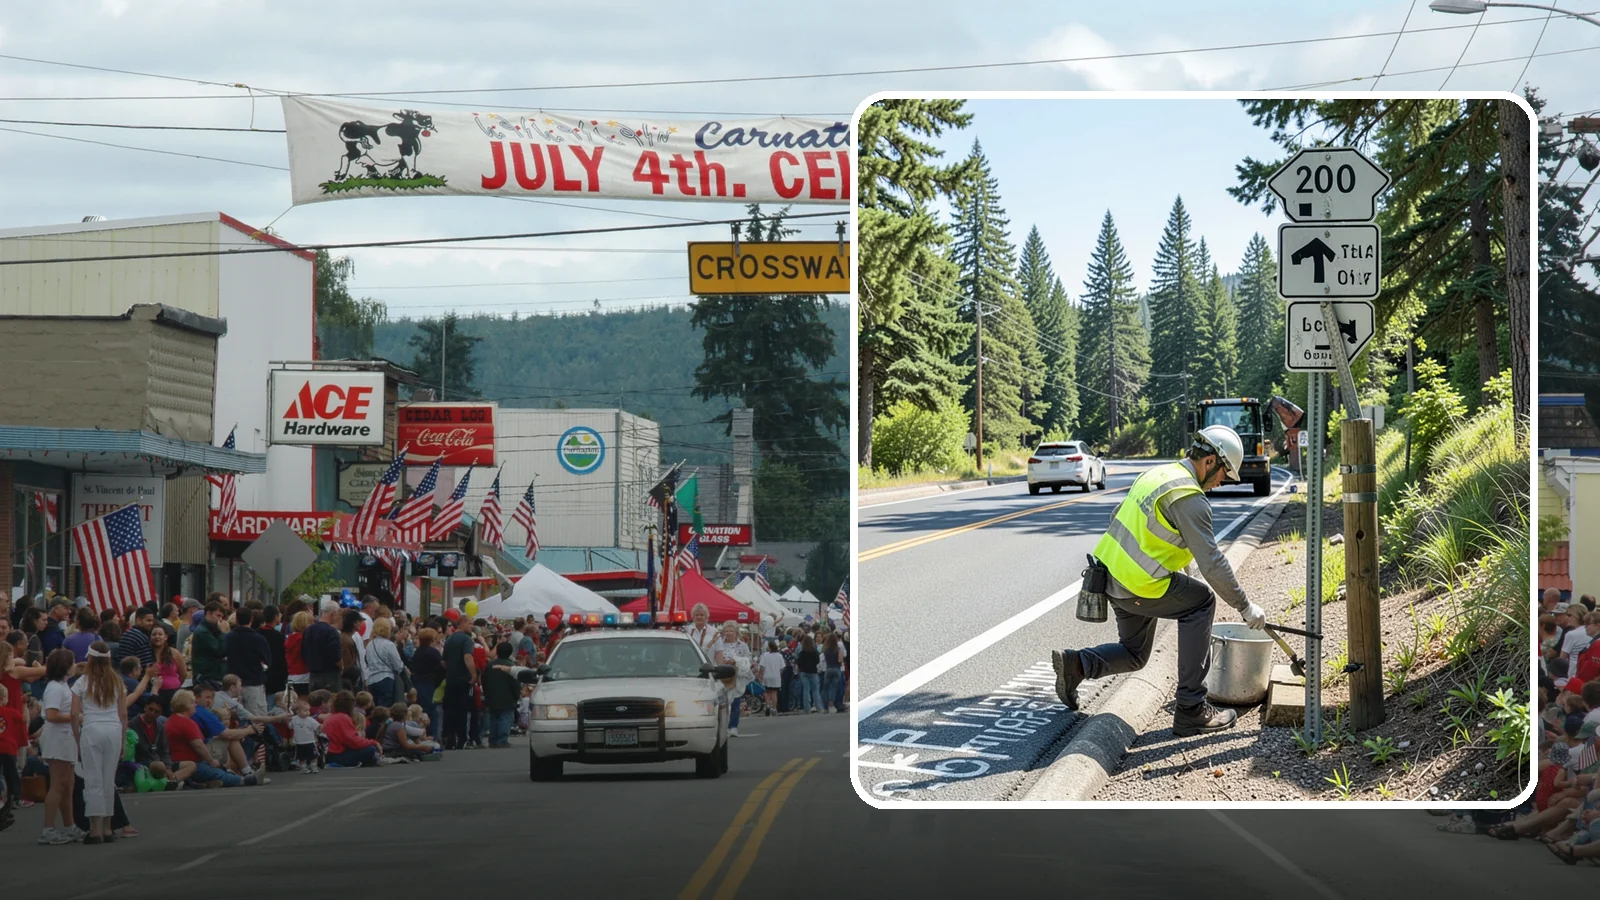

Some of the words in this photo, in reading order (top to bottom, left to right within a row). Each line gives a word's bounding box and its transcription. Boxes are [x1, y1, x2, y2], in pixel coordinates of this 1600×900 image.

[481, 141, 604, 192] JULY
[632, 150, 746, 197] 4th.
[1296, 164, 1356, 194] 200
[697, 254, 850, 279] CROSSWA
[283, 380, 373, 420] ACE
[406, 409, 452, 421] CEDAR
[283, 421, 370, 436] Hardware
[83, 484, 94, 494] St.
[96, 485, 124, 494] Vincent
[126, 486, 136, 495] de
[138, 486, 155, 495] Paul
[688, 526, 741, 535] CRNATION
